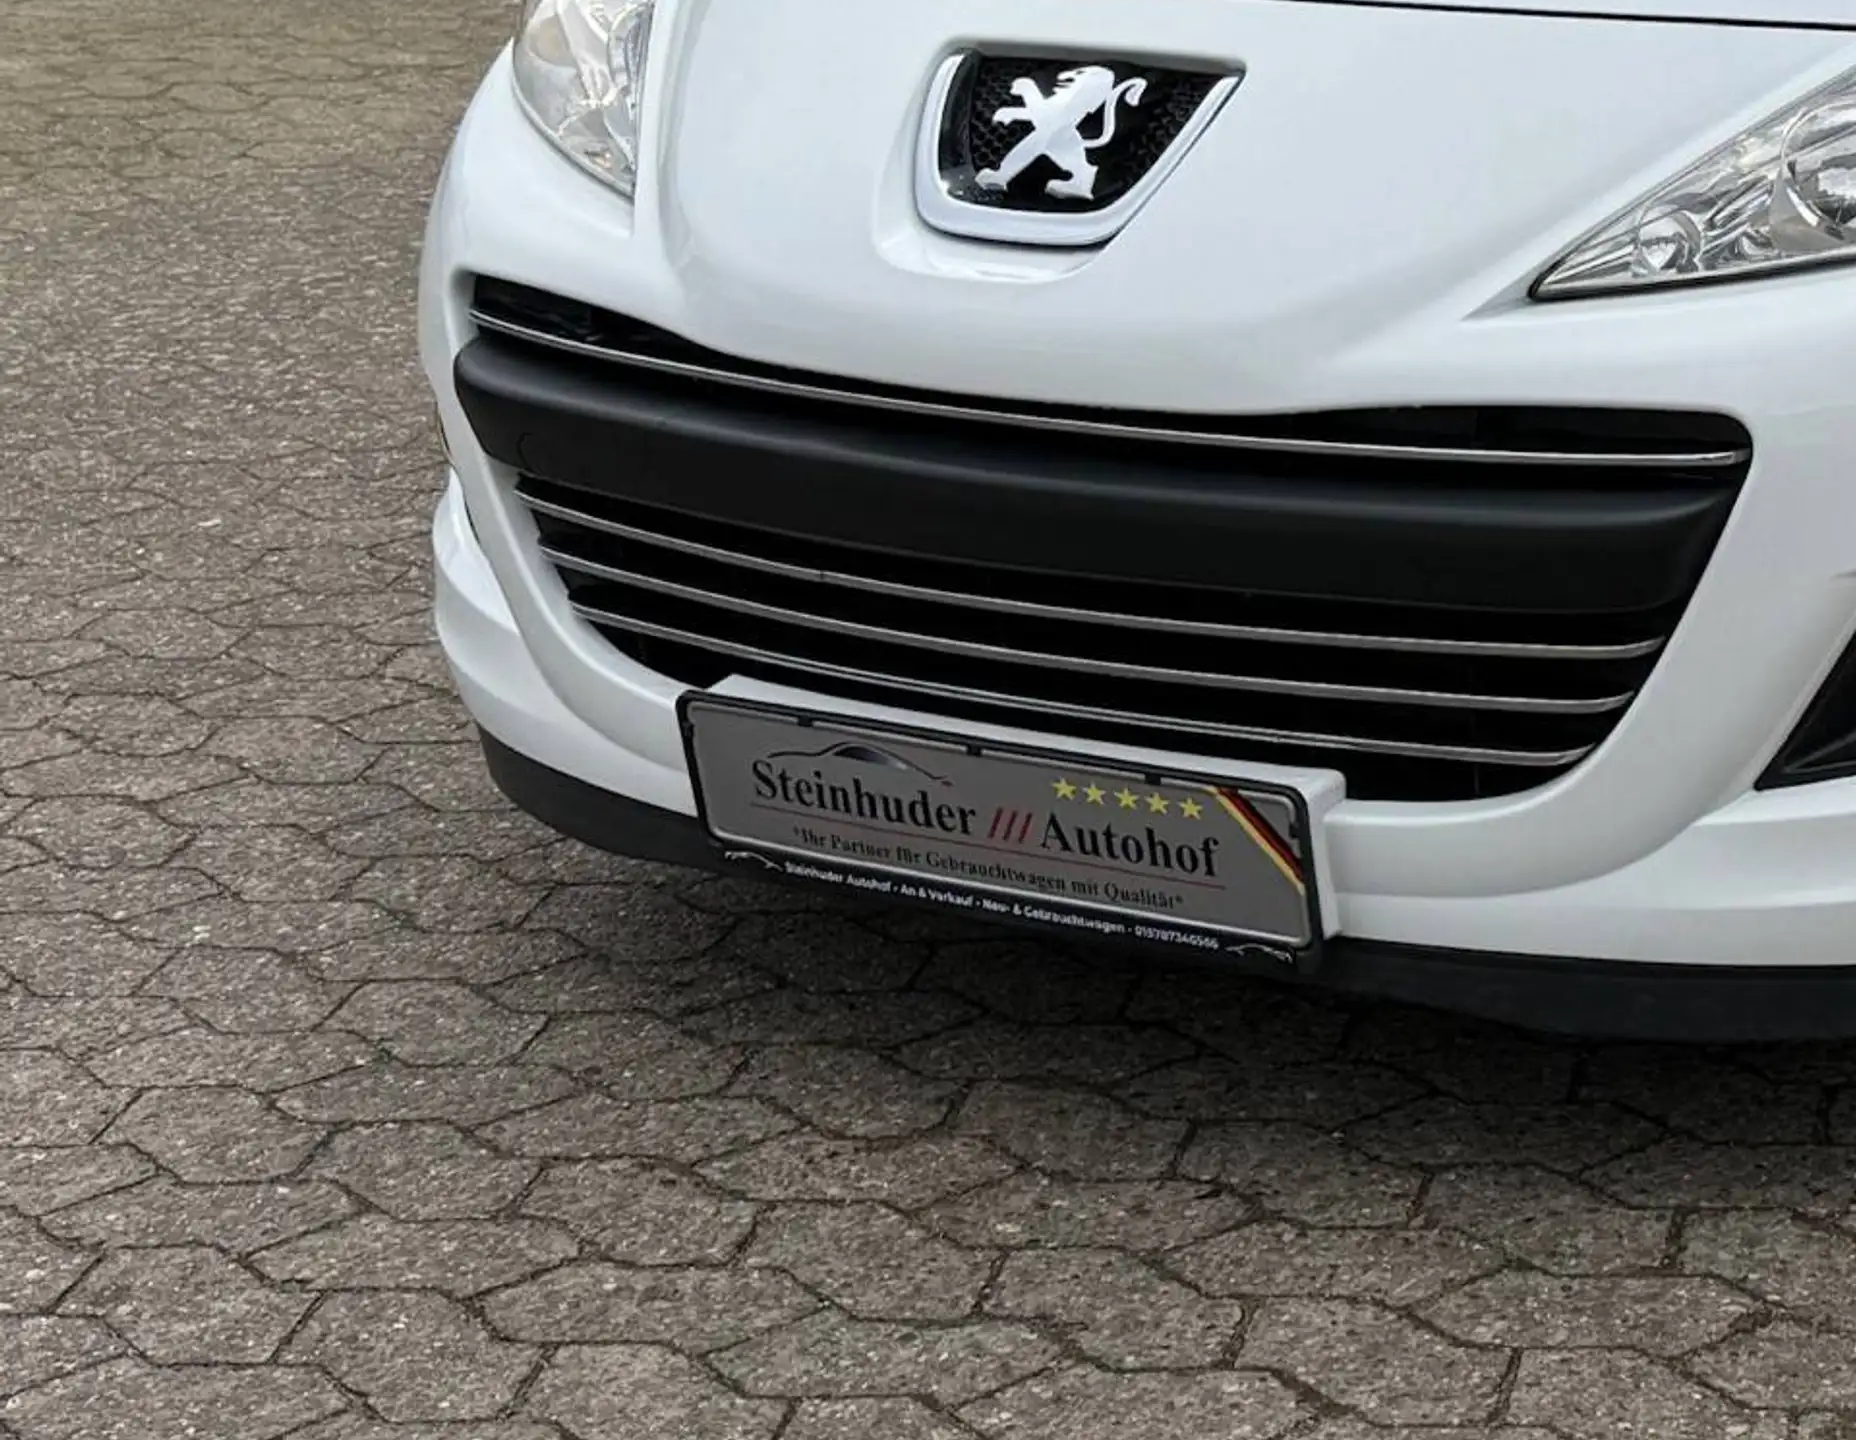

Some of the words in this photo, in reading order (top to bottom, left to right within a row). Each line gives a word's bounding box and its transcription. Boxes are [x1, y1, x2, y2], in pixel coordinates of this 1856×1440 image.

[752, 758, 976, 835] Steinhuder
[1040, 813, 1219, 877] Autohof
[830, 833, 890, 860] Partner
[1072, 881, 1100, 897] mit
